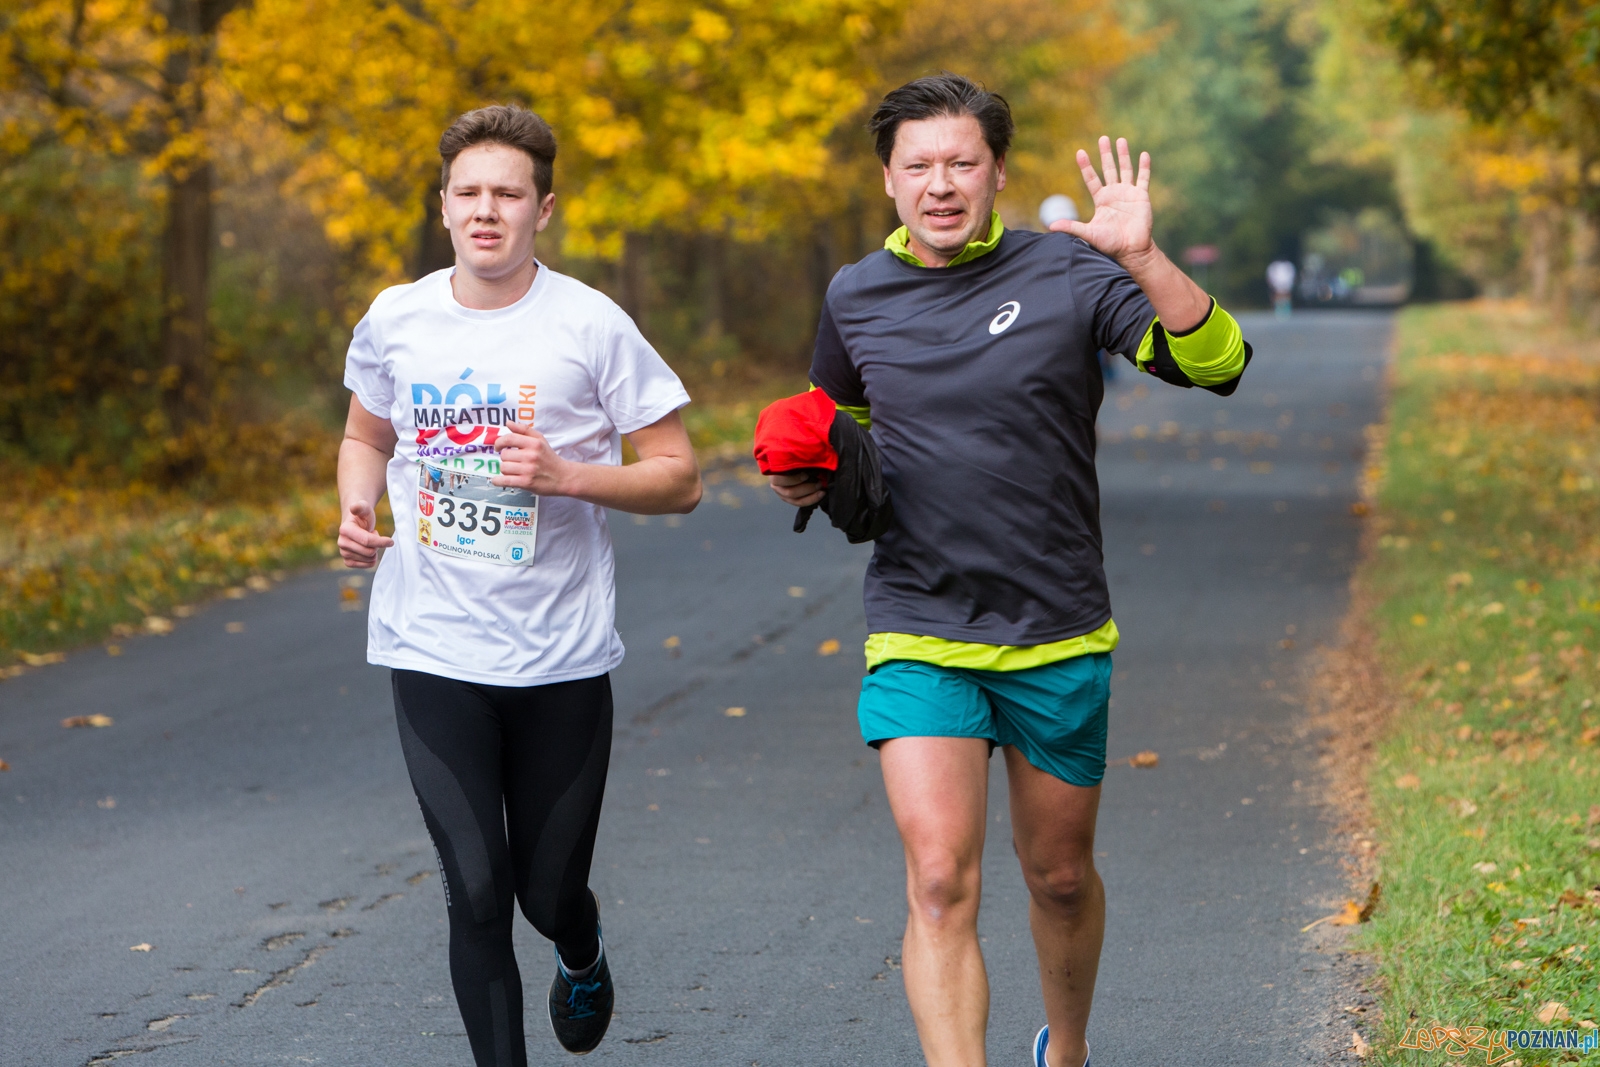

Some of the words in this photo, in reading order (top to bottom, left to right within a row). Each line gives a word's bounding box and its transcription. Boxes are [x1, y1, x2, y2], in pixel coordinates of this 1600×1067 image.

[518, 385, 536, 428] OKI
[414, 407, 516, 427] MARATON
[437, 498, 502, 536] 335
[456, 534, 476, 545] Igor
[438, 542, 472, 555] POLINOVA
[473, 550, 500, 560] POLSKA
